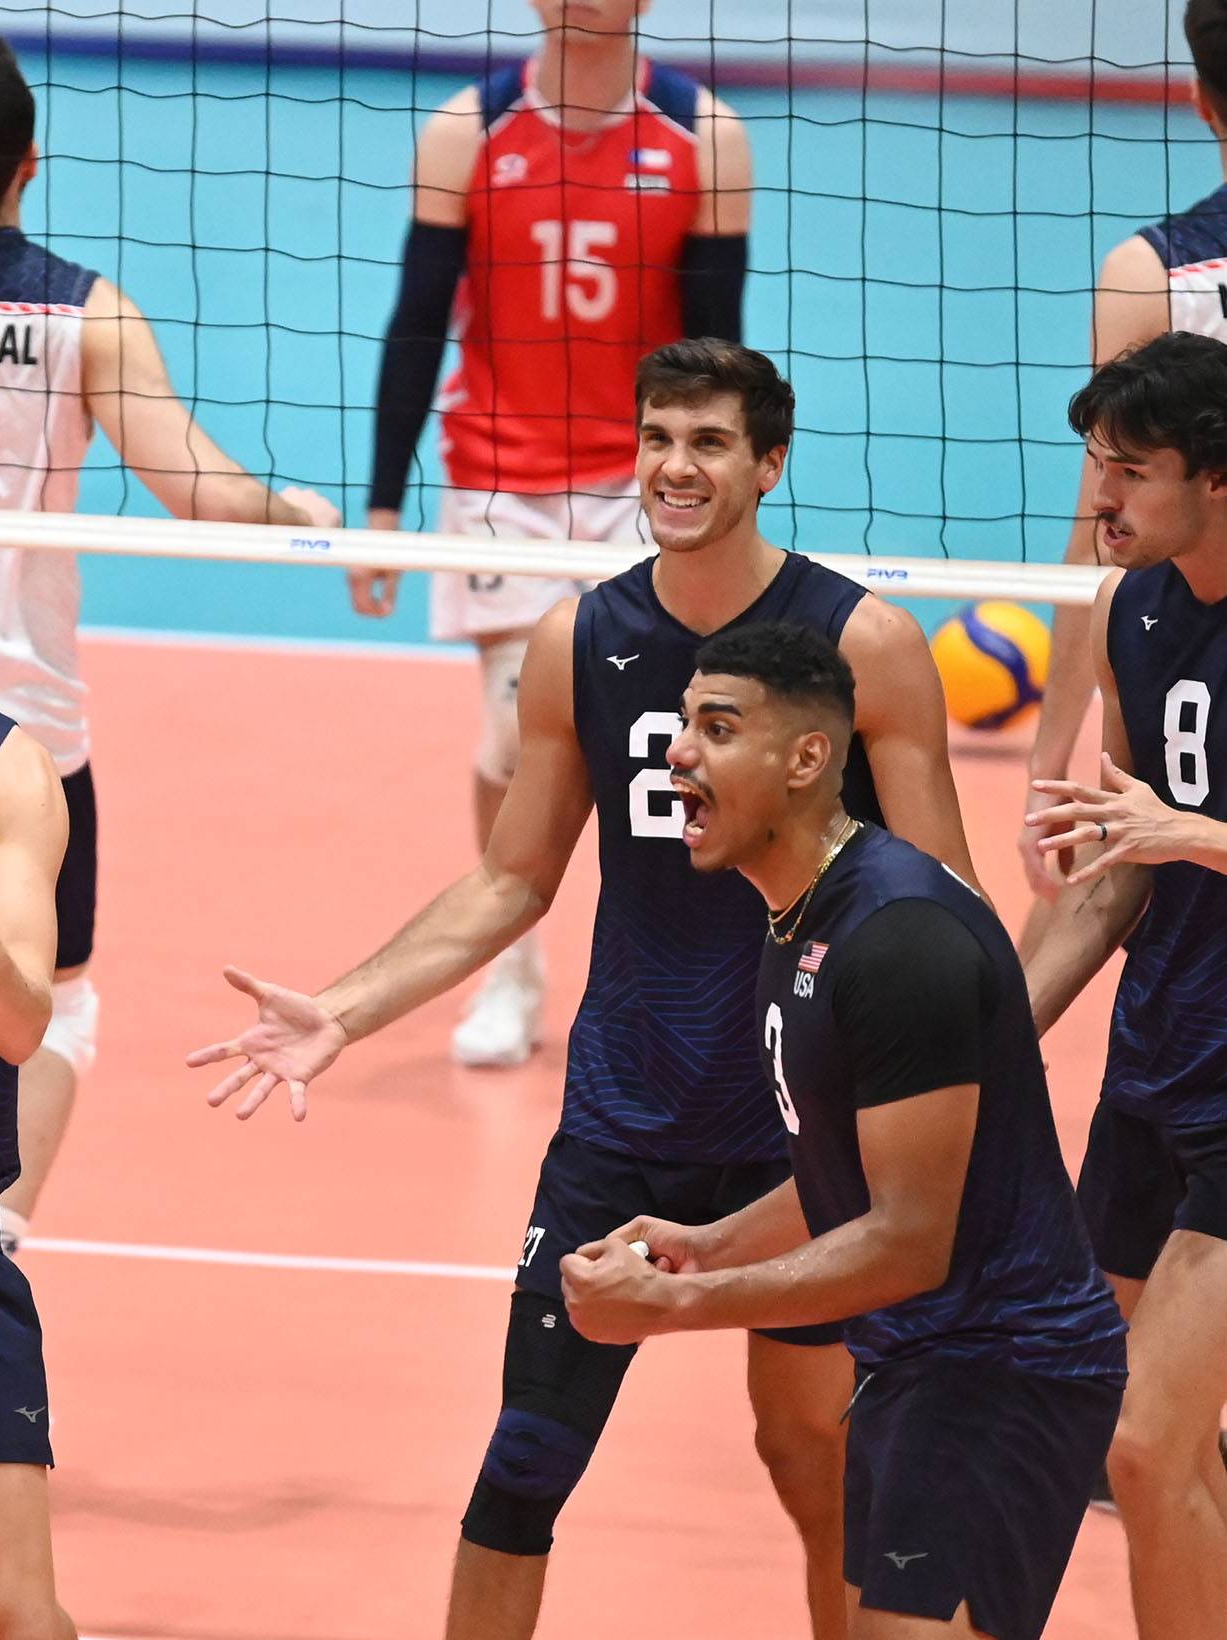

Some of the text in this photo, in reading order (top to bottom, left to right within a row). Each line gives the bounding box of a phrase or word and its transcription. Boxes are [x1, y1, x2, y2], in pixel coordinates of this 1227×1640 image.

[531, 219, 618, 321] 15
[1163, 679, 1211, 807] 8
[794, 970, 815, 999] USA
